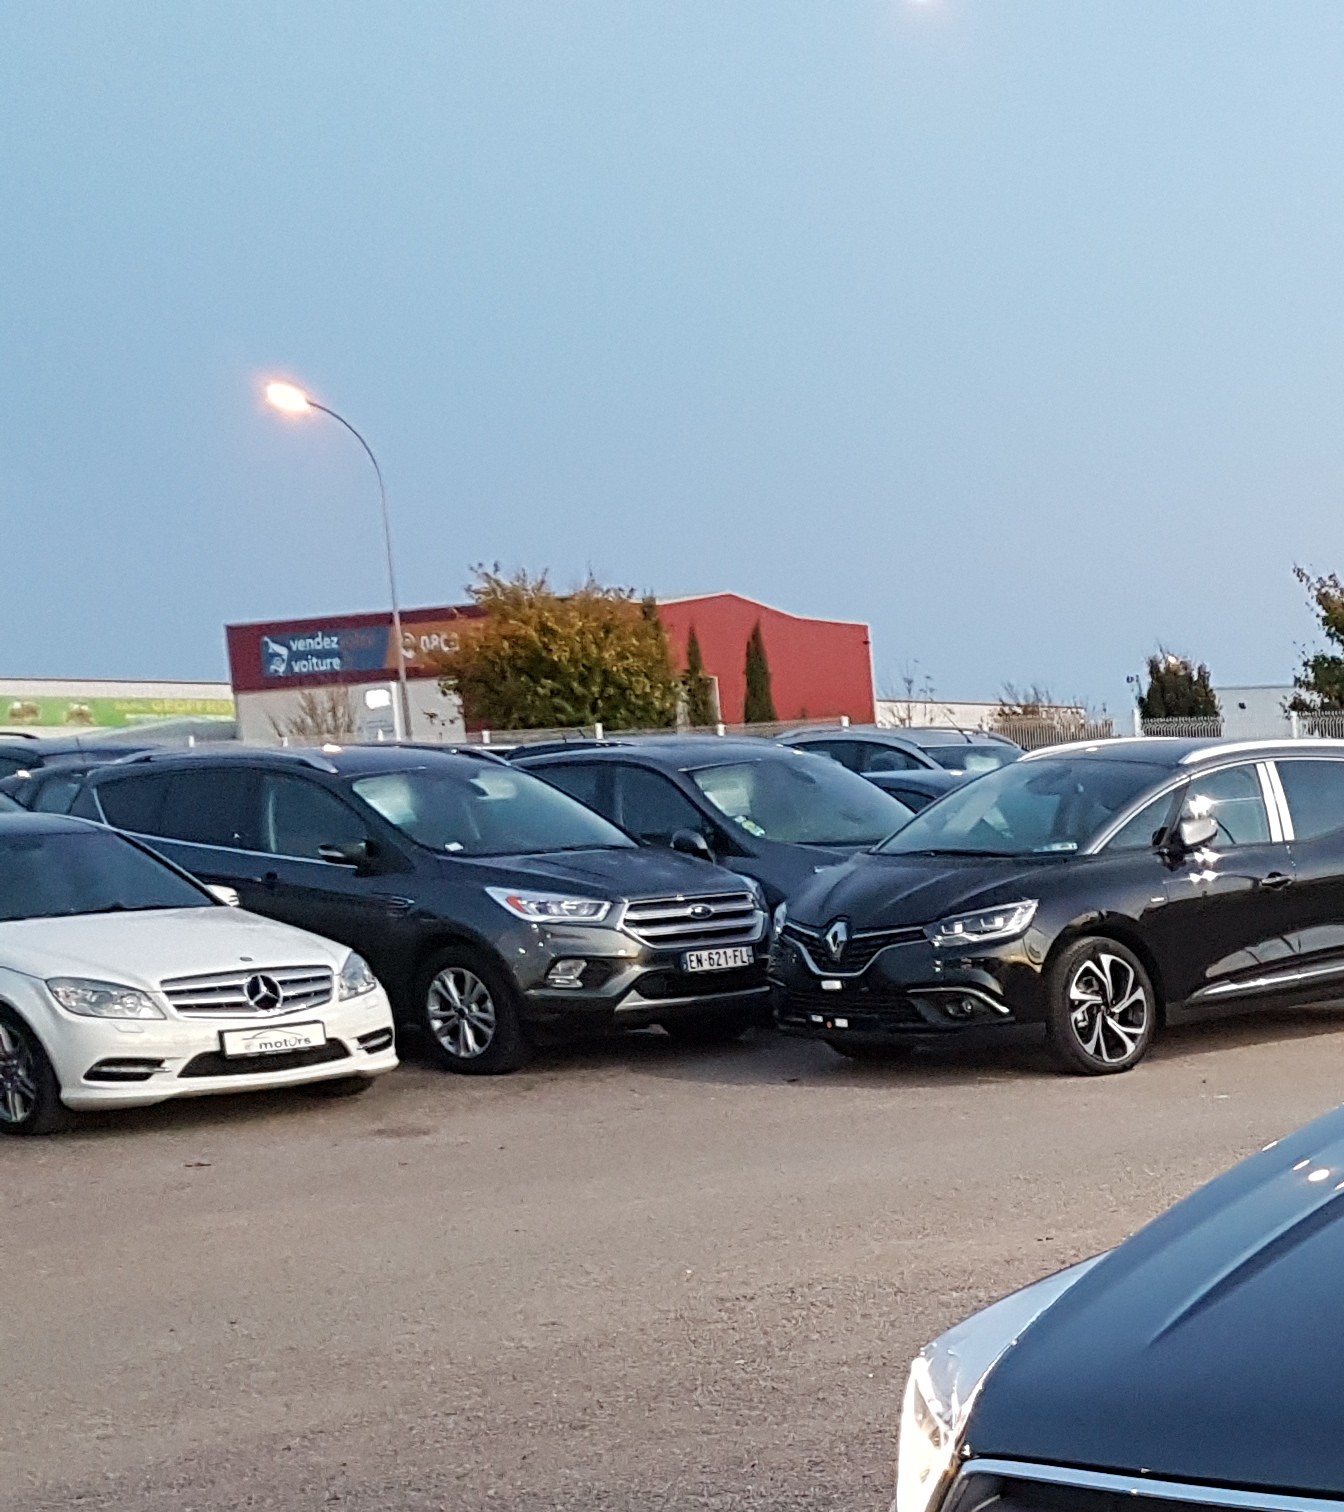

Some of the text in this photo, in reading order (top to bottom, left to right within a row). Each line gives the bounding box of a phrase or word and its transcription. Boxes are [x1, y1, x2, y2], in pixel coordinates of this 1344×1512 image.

[289, 631, 339, 651] vendez
[291, 654, 342, 672] voiture
[688, 949, 748, 970] EN-621-FL
